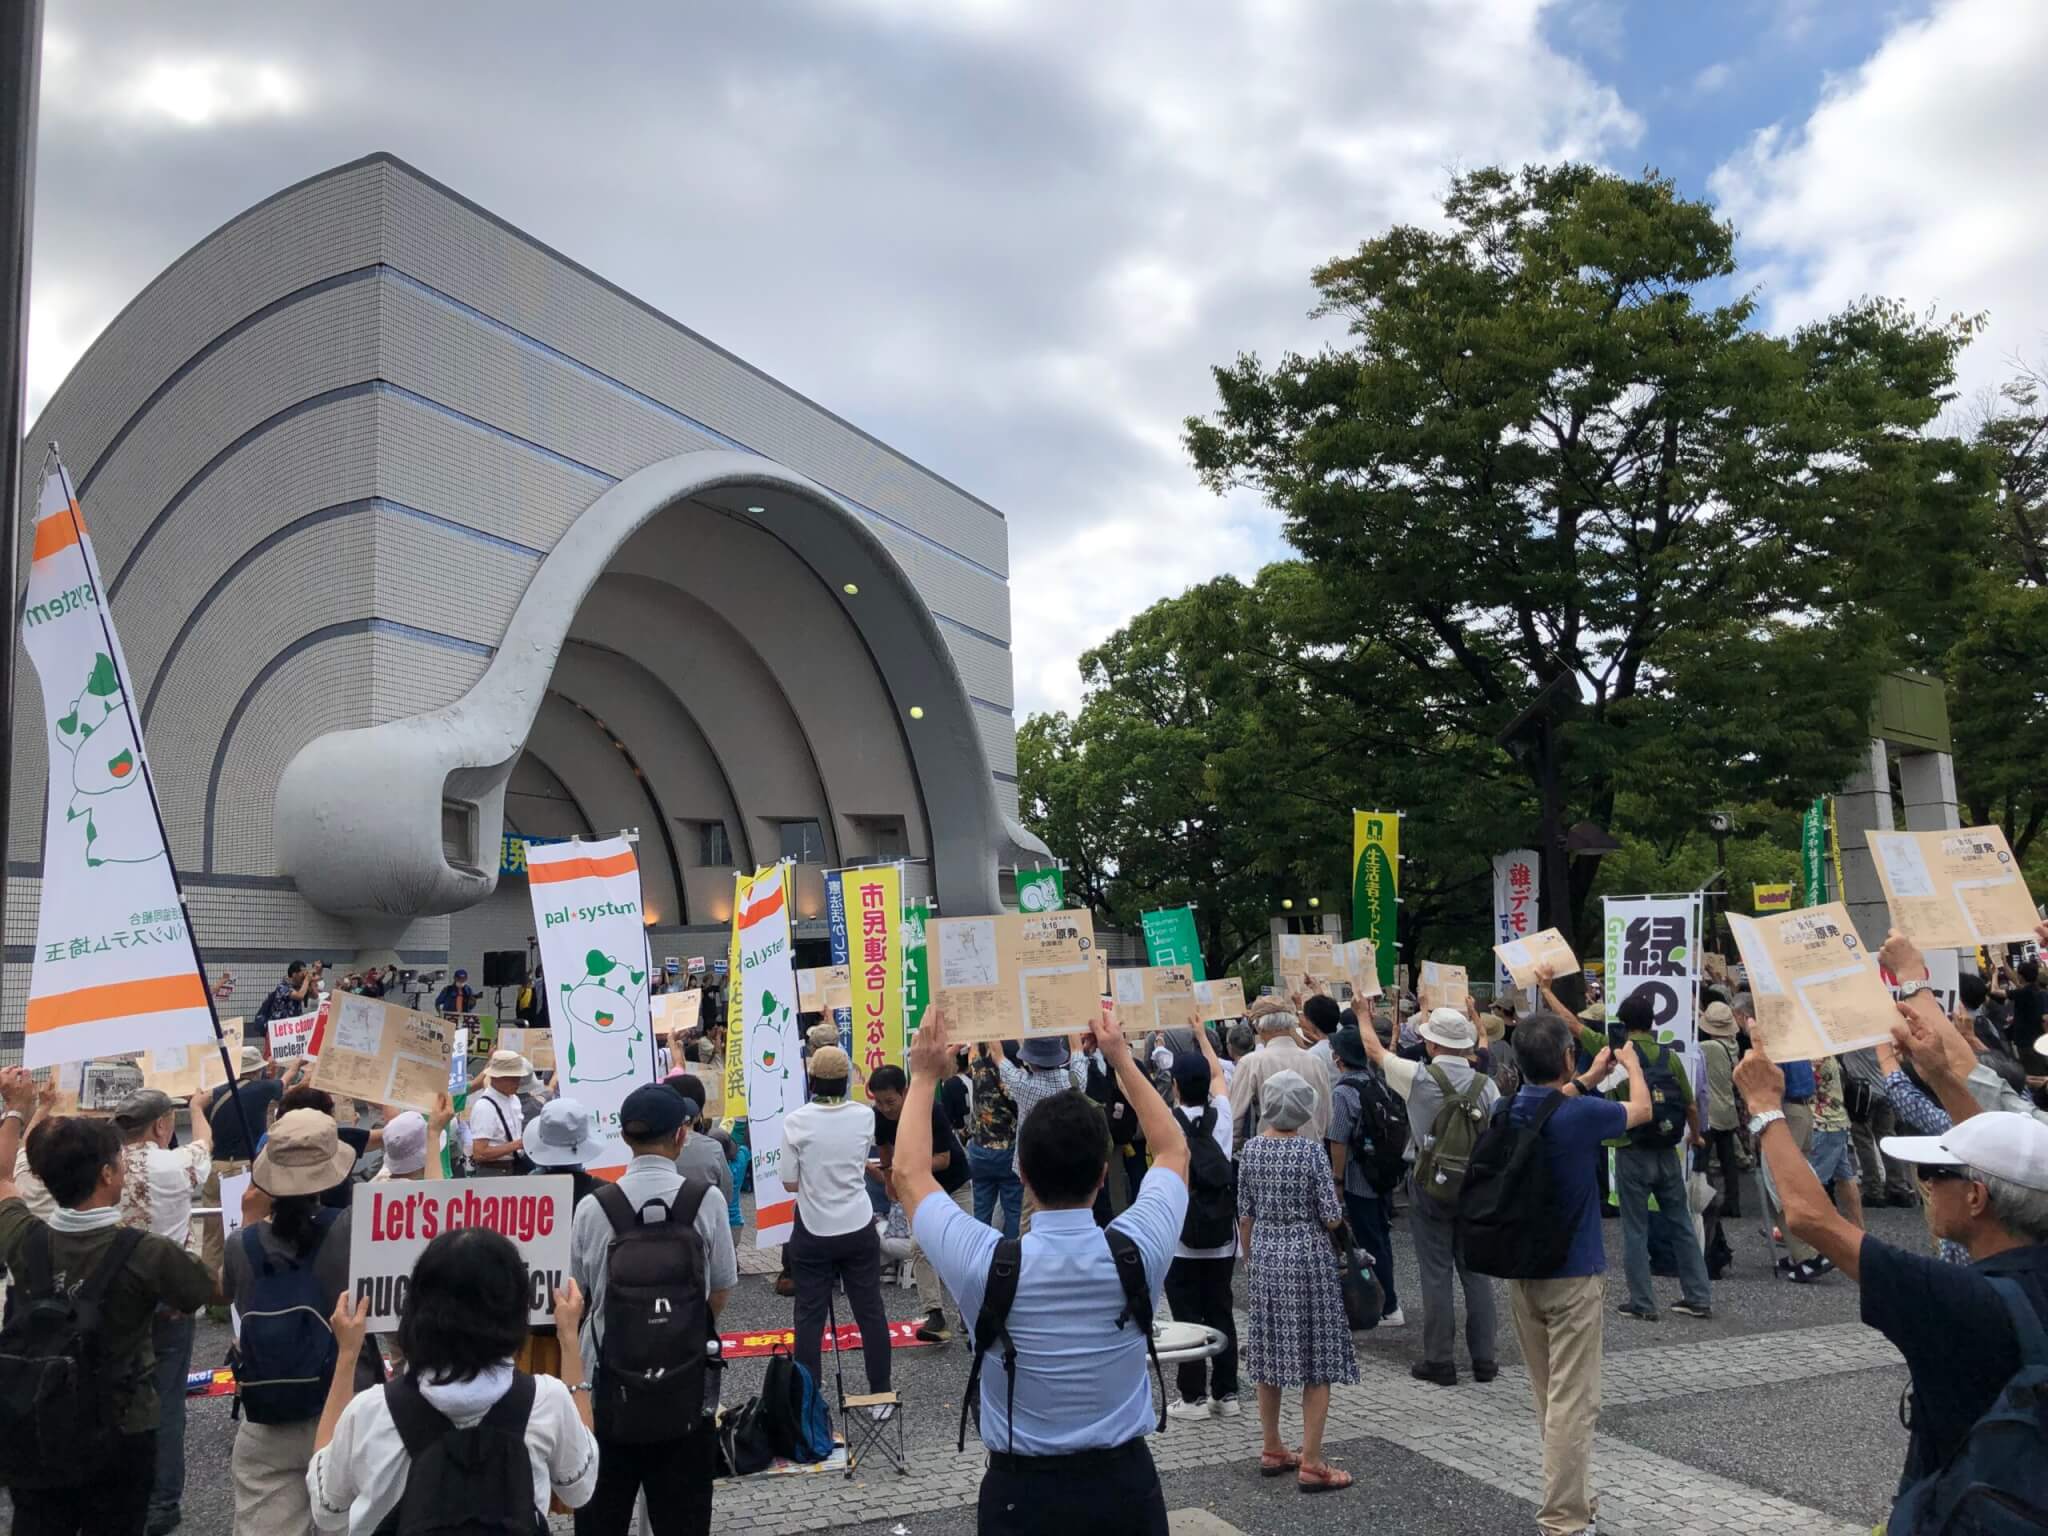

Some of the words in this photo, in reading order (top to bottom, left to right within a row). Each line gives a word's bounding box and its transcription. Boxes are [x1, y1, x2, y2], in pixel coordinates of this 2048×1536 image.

[545, 906, 570, 928] pal
[1607, 916, 1625, 1004] Greens
[372, 1192, 439, 1242] Let's
[446, 1189, 554, 1242] change
